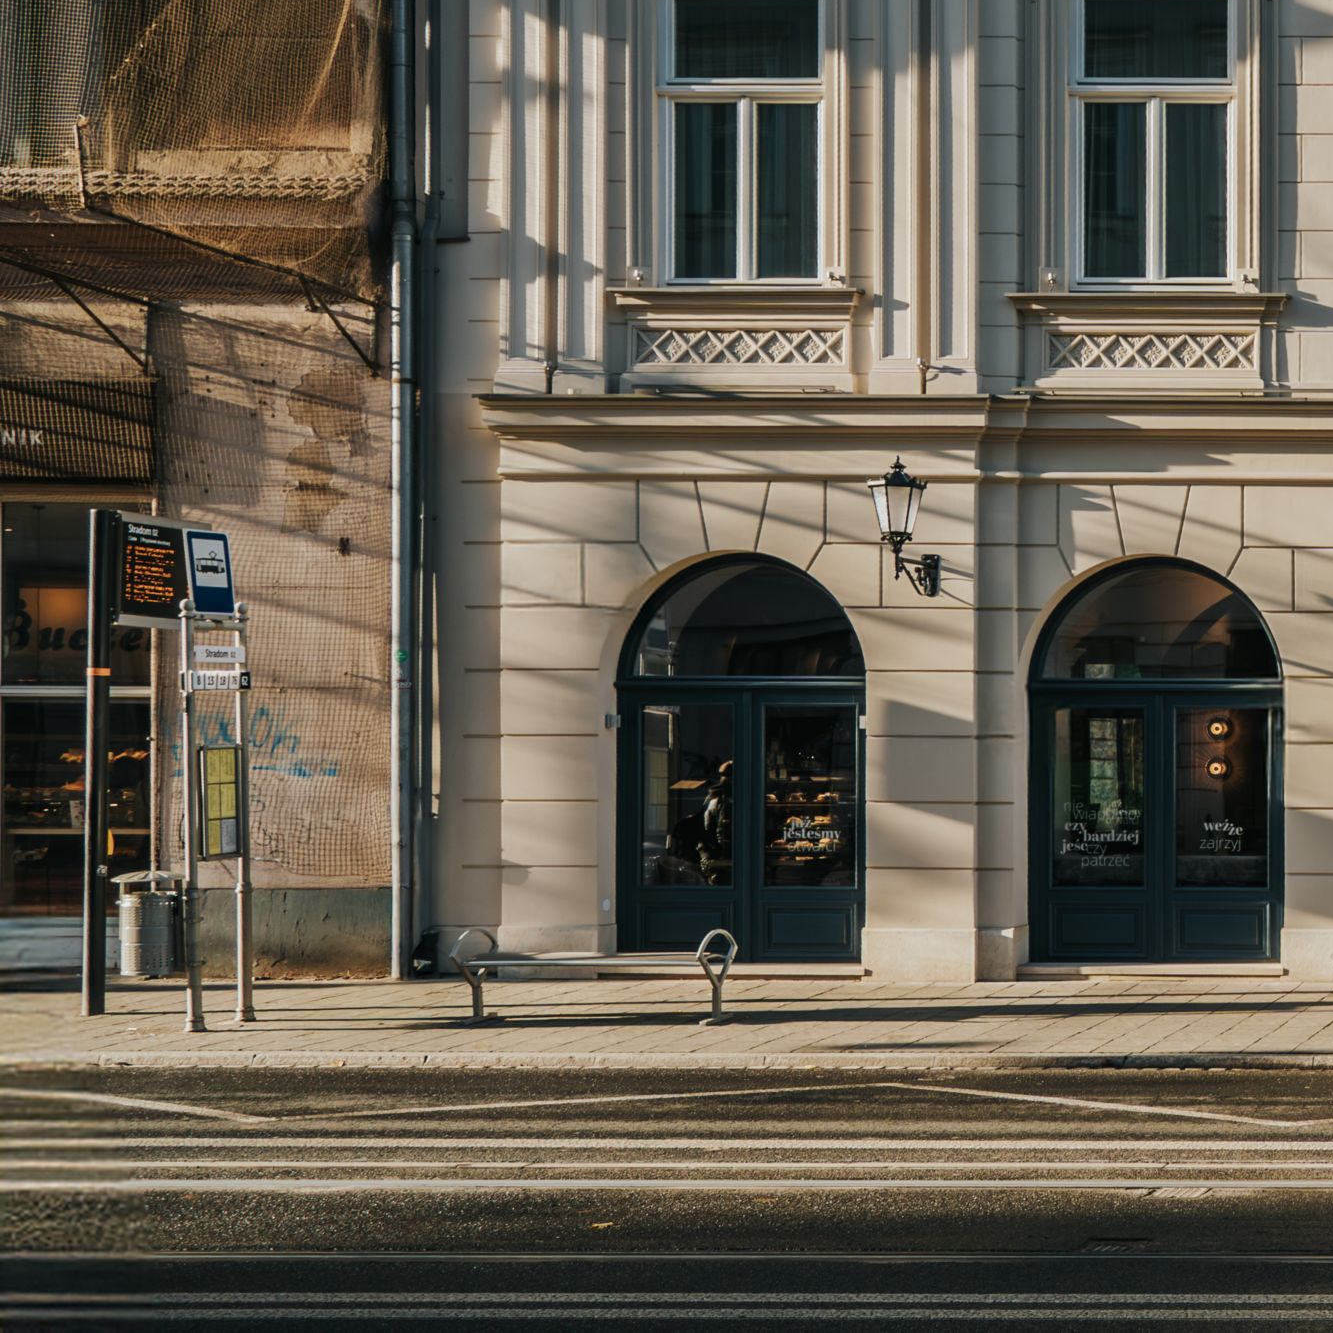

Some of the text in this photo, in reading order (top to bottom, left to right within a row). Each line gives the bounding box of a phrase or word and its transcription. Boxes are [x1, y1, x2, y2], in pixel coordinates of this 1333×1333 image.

[128, 523, 151, 536] Stradom
[205, 648, 229, 659] Stradom
[782, 827, 841, 842] jesteśmy
[1064, 821, 1087, 835] czy
[1083, 829, 1139, 845] bardziej
[1199, 836, 1241, 852] zajrzyj
[1081, 853, 1131, 870] patrzeć
